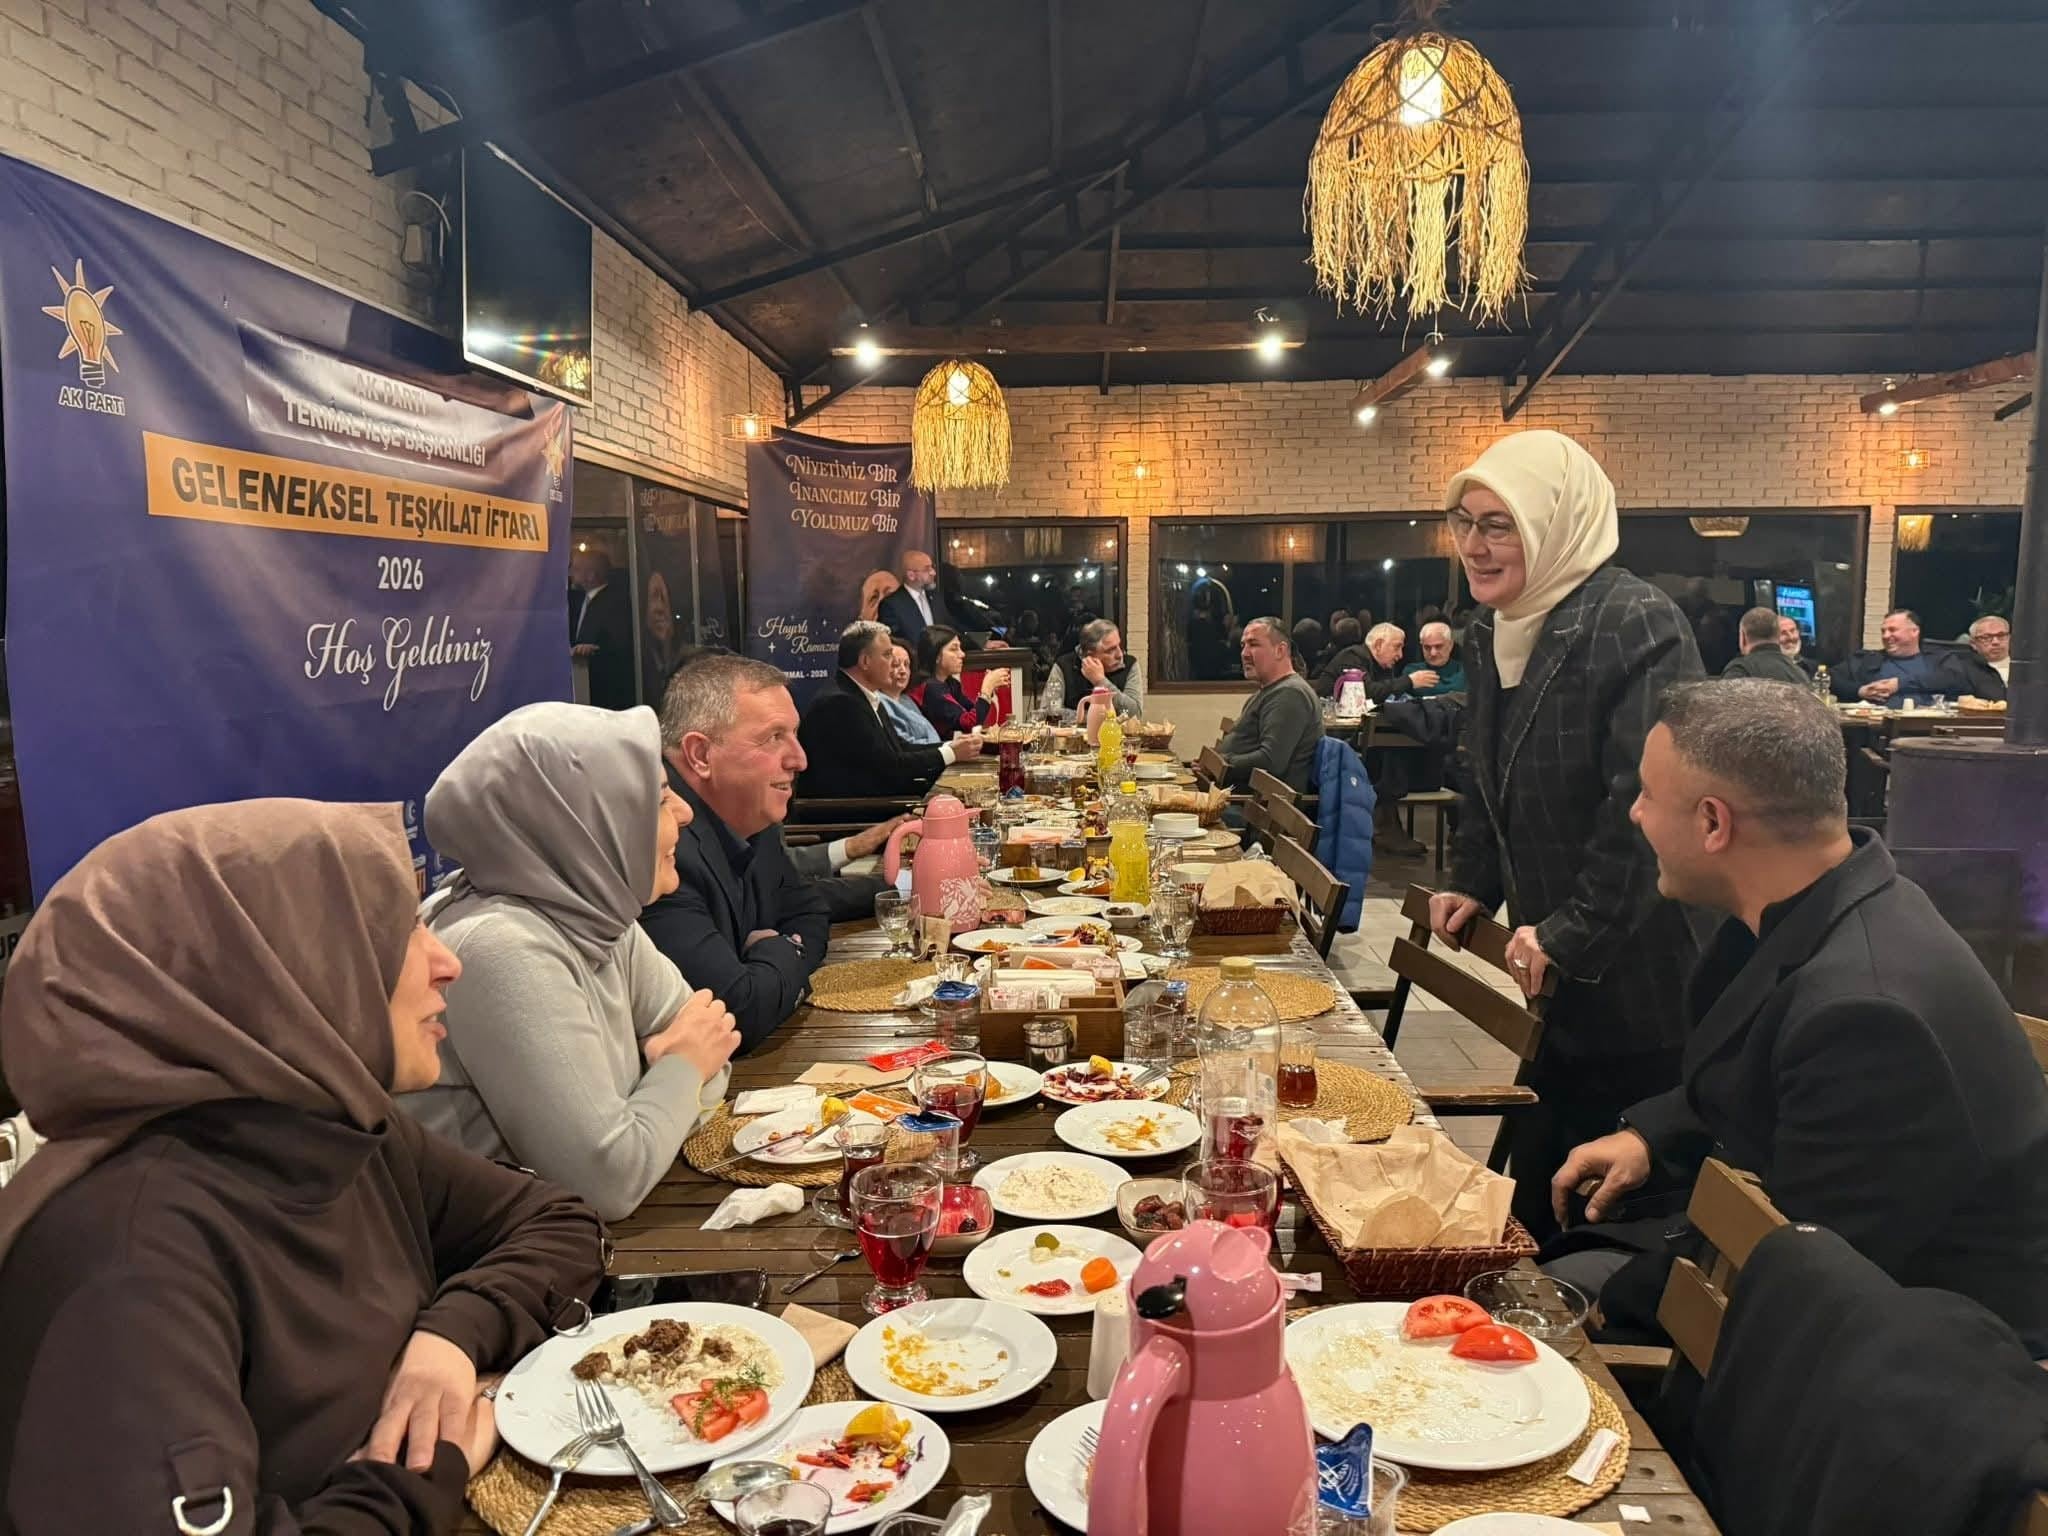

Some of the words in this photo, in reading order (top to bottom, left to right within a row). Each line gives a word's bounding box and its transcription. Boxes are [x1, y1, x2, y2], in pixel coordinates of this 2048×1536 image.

[58, 385, 83, 408] AK
[354, 373, 380, 401] AK
[283, 396, 360, 437] TERMAL
[785, 454, 865, 480] NİYETİMİZ
[172, 457, 378, 524] GELENEKSEL
[386, 491, 481, 537] TEŞKİLAT
[486, 500, 540, 541] İFTARI
[789, 476, 868, 505] İNANCIMIZ
[791, 508, 870, 531] YOLUMUZ
[377, 555, 424, 590] 2026
[304, 618, 376, 685] Hoş
[382, 615, 492, 711] Geldiniz
